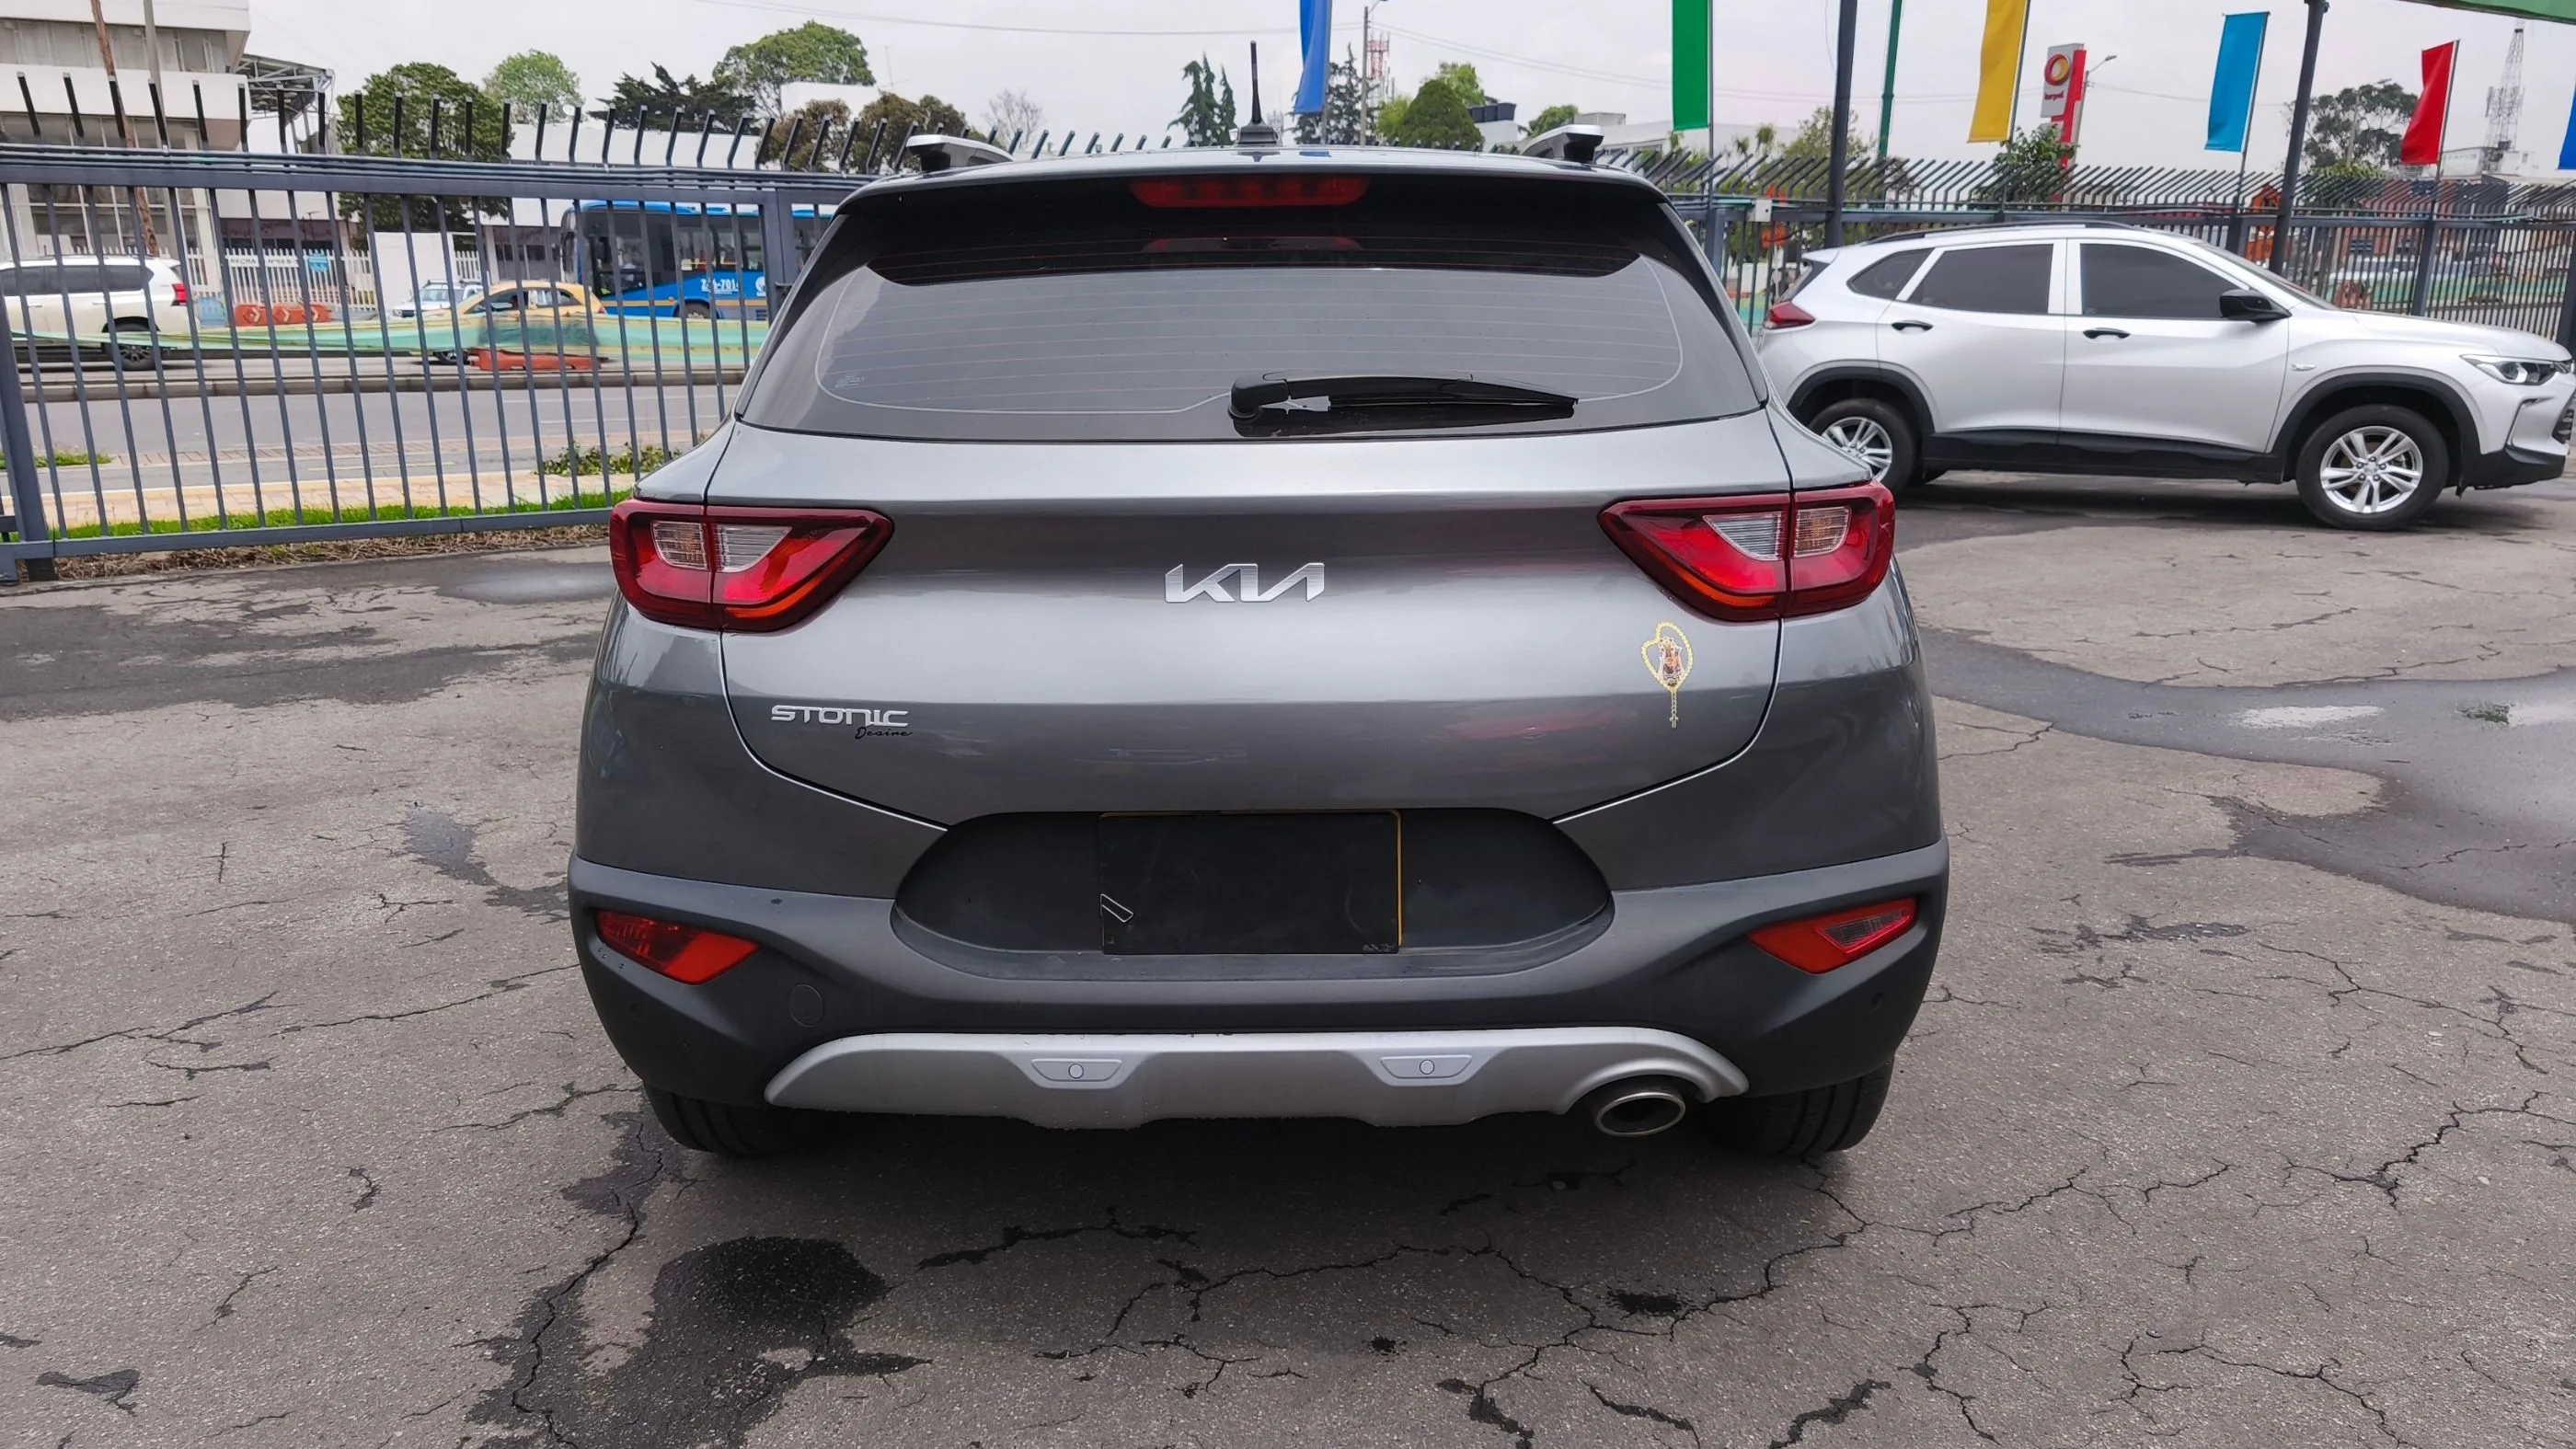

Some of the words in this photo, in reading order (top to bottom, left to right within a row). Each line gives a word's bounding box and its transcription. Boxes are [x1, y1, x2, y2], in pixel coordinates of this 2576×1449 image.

[1165, 562, 1325, 604] KIA
[770, 705, 909, 728] STONIC
[854, 726, 913, 740] Desire
